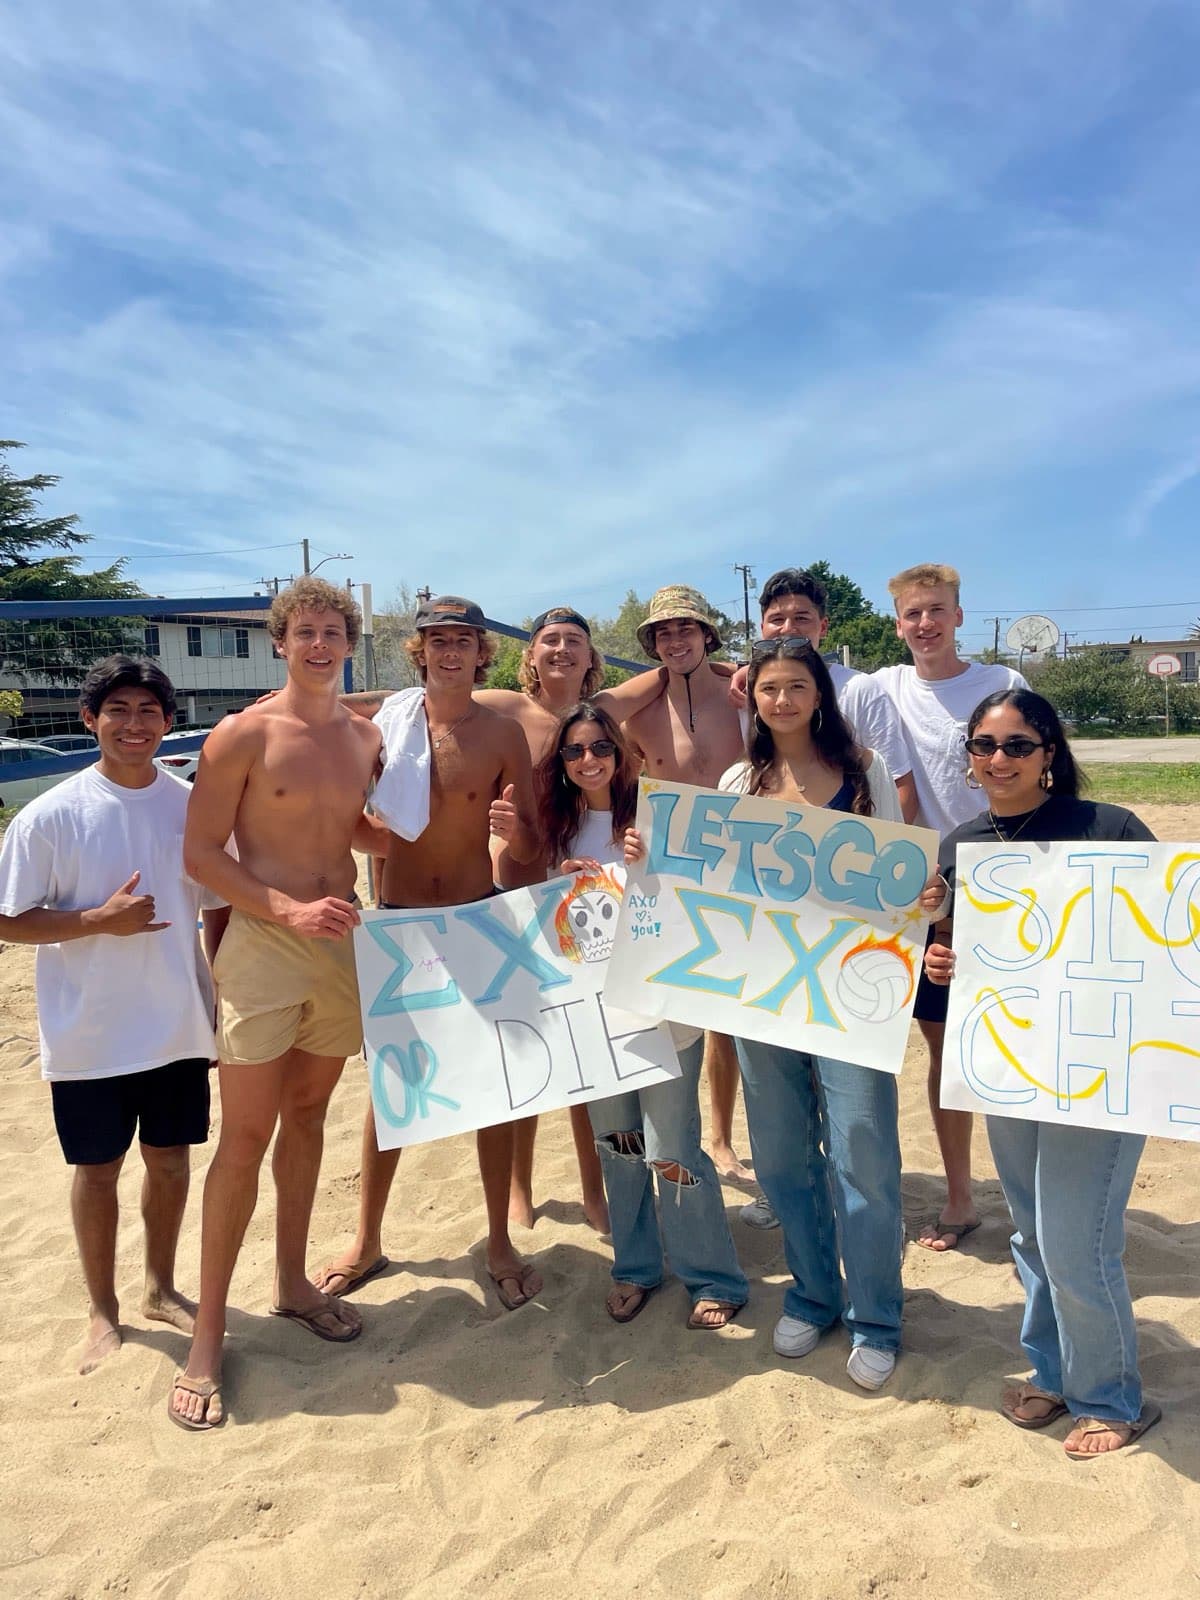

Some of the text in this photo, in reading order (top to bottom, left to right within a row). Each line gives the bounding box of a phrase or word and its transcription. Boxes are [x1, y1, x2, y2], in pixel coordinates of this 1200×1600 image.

[646, 793, 928, 911] LET'S GO
[631, 922, 661, 941] you!
[373, 1040, 461, 1128] OR
[495, 991, 662, 1109] DIE
